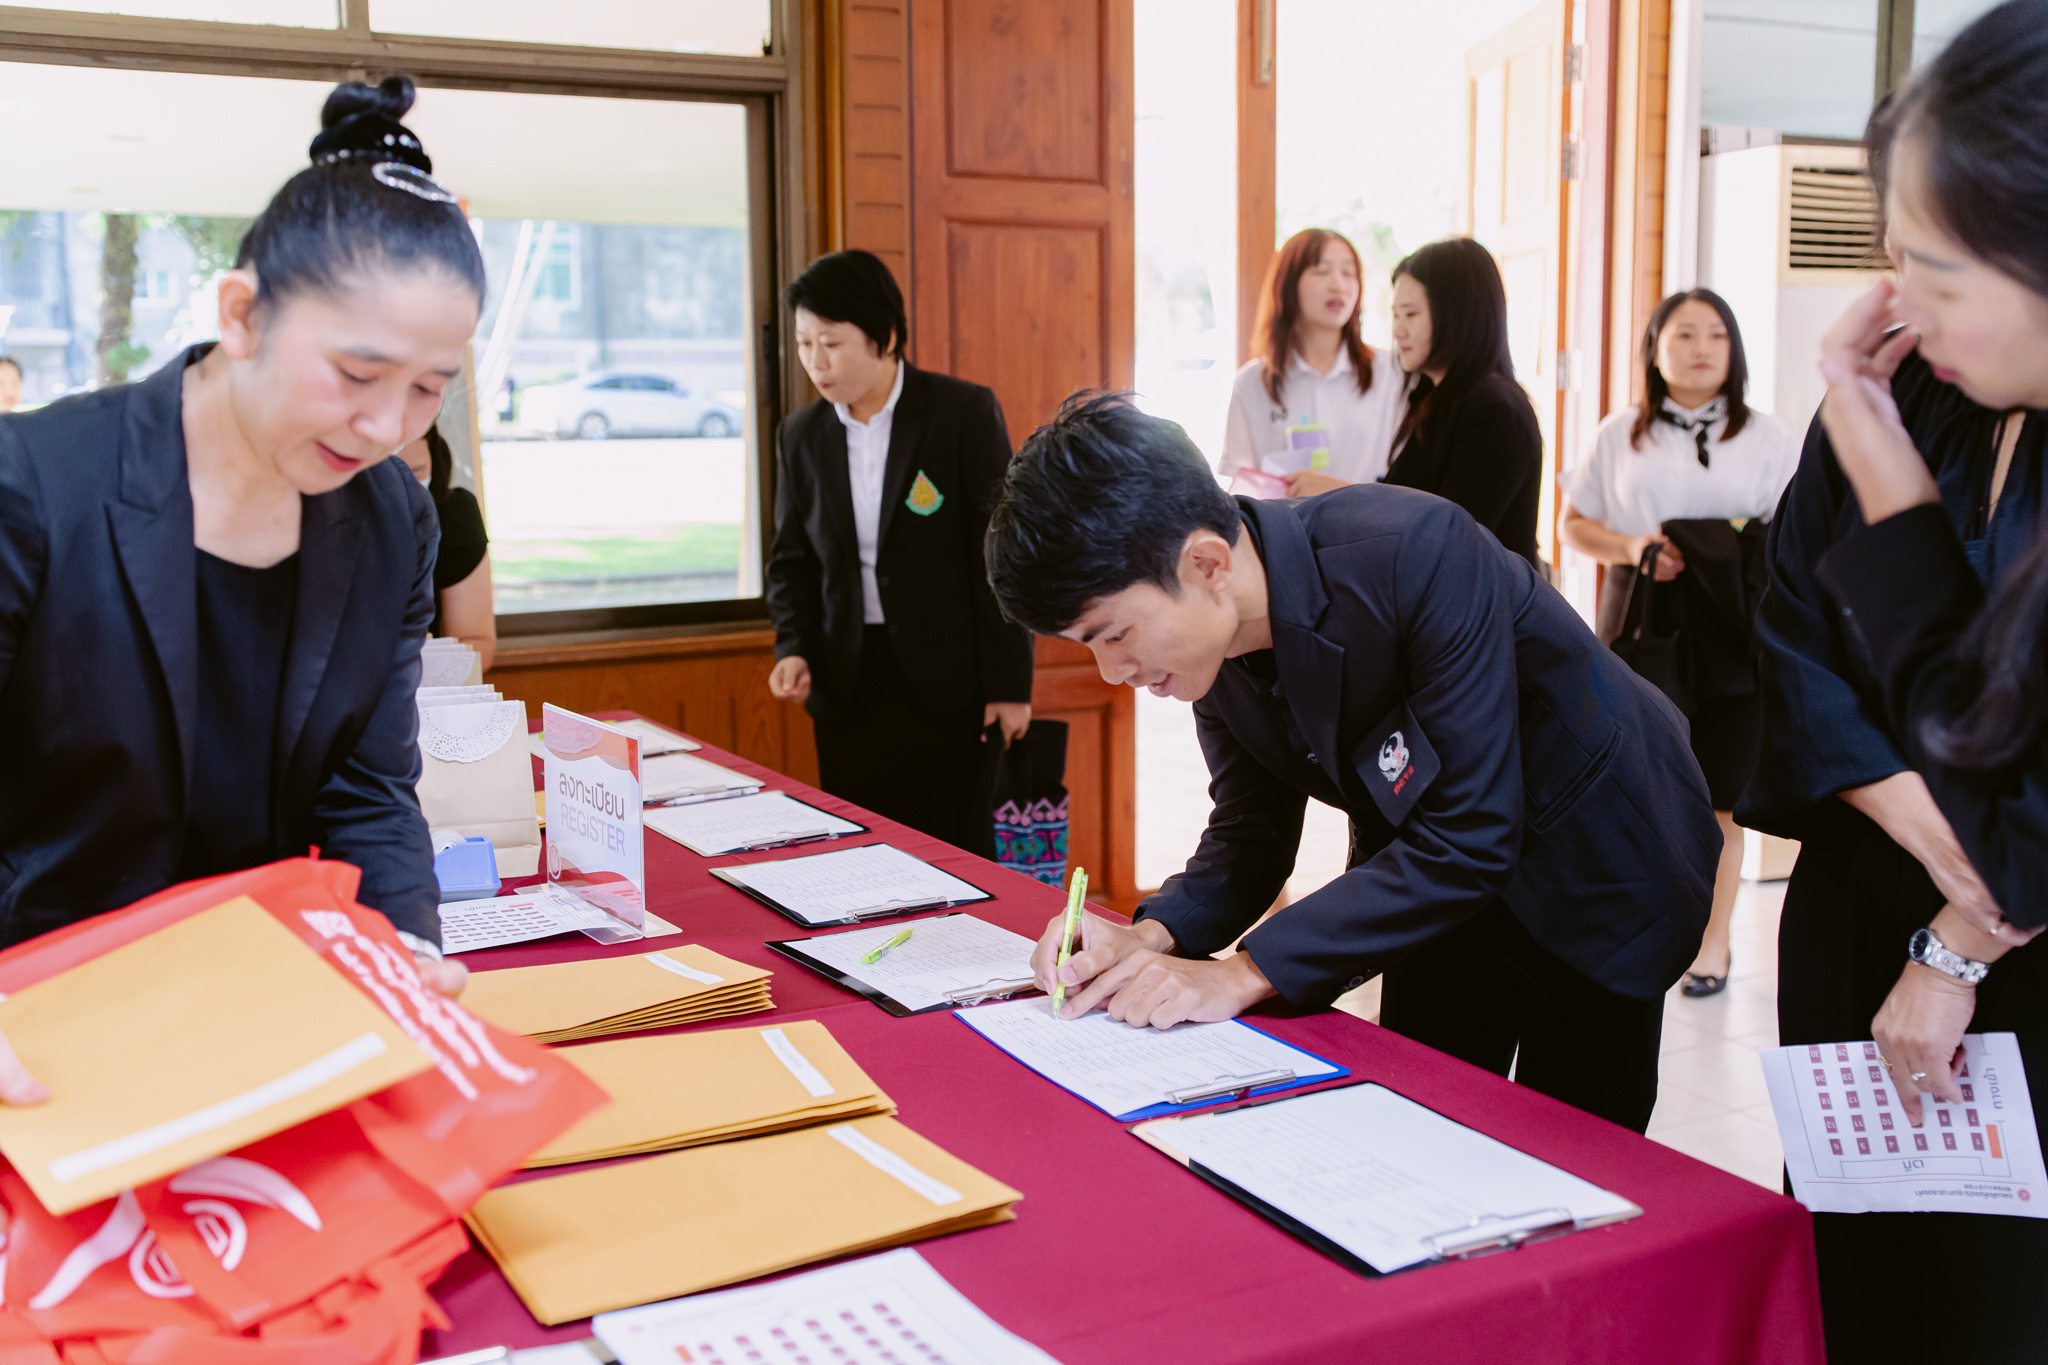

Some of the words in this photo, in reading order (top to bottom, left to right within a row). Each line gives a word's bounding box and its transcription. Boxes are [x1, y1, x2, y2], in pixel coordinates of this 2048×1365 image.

[559, 771, 625, 821] ลงทะเบียน
[560, 802, 626, 856] REGISTER
[1811, 1050, 1820, 1058] 30
[1983, 1068, 2003, 1109] ทางเข้า
[1826, 1120, 1836, 1128] 12
[1882, 1118, 1892, 1126] 10
[1860, 1142, 1866, 1150] 5
[1902, 1159, 1924, 1172] เวที
